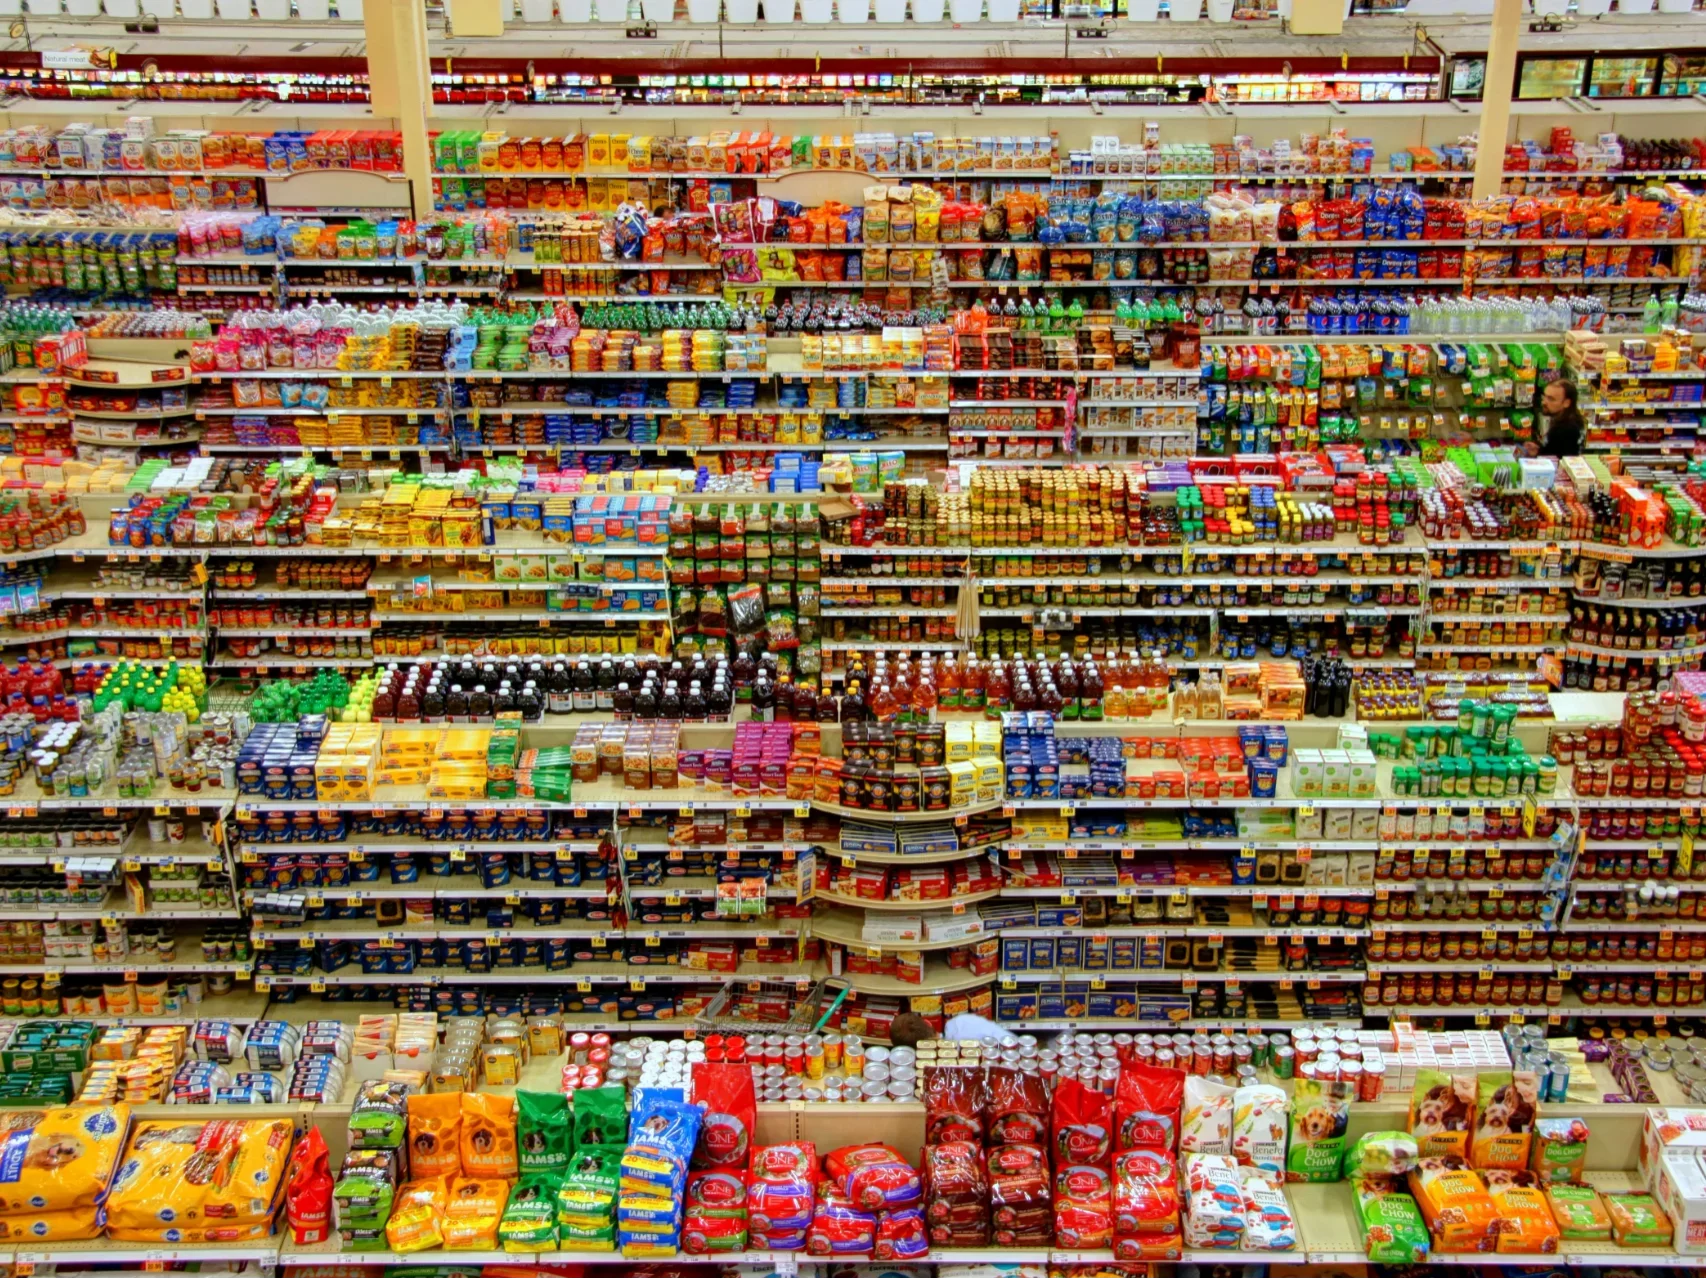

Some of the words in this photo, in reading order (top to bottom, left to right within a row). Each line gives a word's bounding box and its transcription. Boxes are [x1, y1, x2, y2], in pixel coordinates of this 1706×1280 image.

[706, 1132, 735, 1143] ONE
[941, 1132, 968, 1142] ONE
[1003, 1130, 1031, 1140] ONE
[1134, 1128, 1162, 1140] ONE
[634, 1134, 667, 1145] IAMS
[1425, 1141, 1447, 1151] DOG
[1490, 1144, 1512, 1153] DOG
[1547, 1147, 1563, 1155] DOG
[1564, 1147, 1582, 1155] CHOW
[1305, 1149, 1329, 1158] DOG
[1488, 1152, 1519, 1162] CHOW
[413, 1156, 446, 1165] IAMS
[469, 1155, 502, 1165] IAMS
[522, 1154, 554, 1164] IAMS
[765, 1156, 794, 1165] ONE
[1000, 1154, 1027, 1164] ONE
[1304, 1156, 1337, 1165] CHOW
[10, 1149, 24, 1180] ADULT
[1127, 1160, 1156, 1169] ONE
[570, 1173, 605, 1183] IAMS
[629, 1168, 649, 1178] IAMS
[1068, 1176, 1097, 1186] ONE
[1440, 1179, 1463, 1188] DOG
[703, 1184, 731, 1194] ONE
[1444, 1185, 1475, 1195] CHOW
[1570, 1189, 1591, 1197] CHOW
[451, 1199, 486, 1207] IAMS
[1504, 1194, 1528, 1203] DOG
[509, 1202, 543, 1210] IAMS
[1379, 1200, 1404, 1211] DOG
[1507, 1201, 1540, 1210] CHOW
[301, 1211, 325, 1220] IAMS
[629, 1209, 649, 1218] IAMS
[1380, 1208, 1415, 1220] CHOW
[632, 1233, 652, 1241] IAMS
